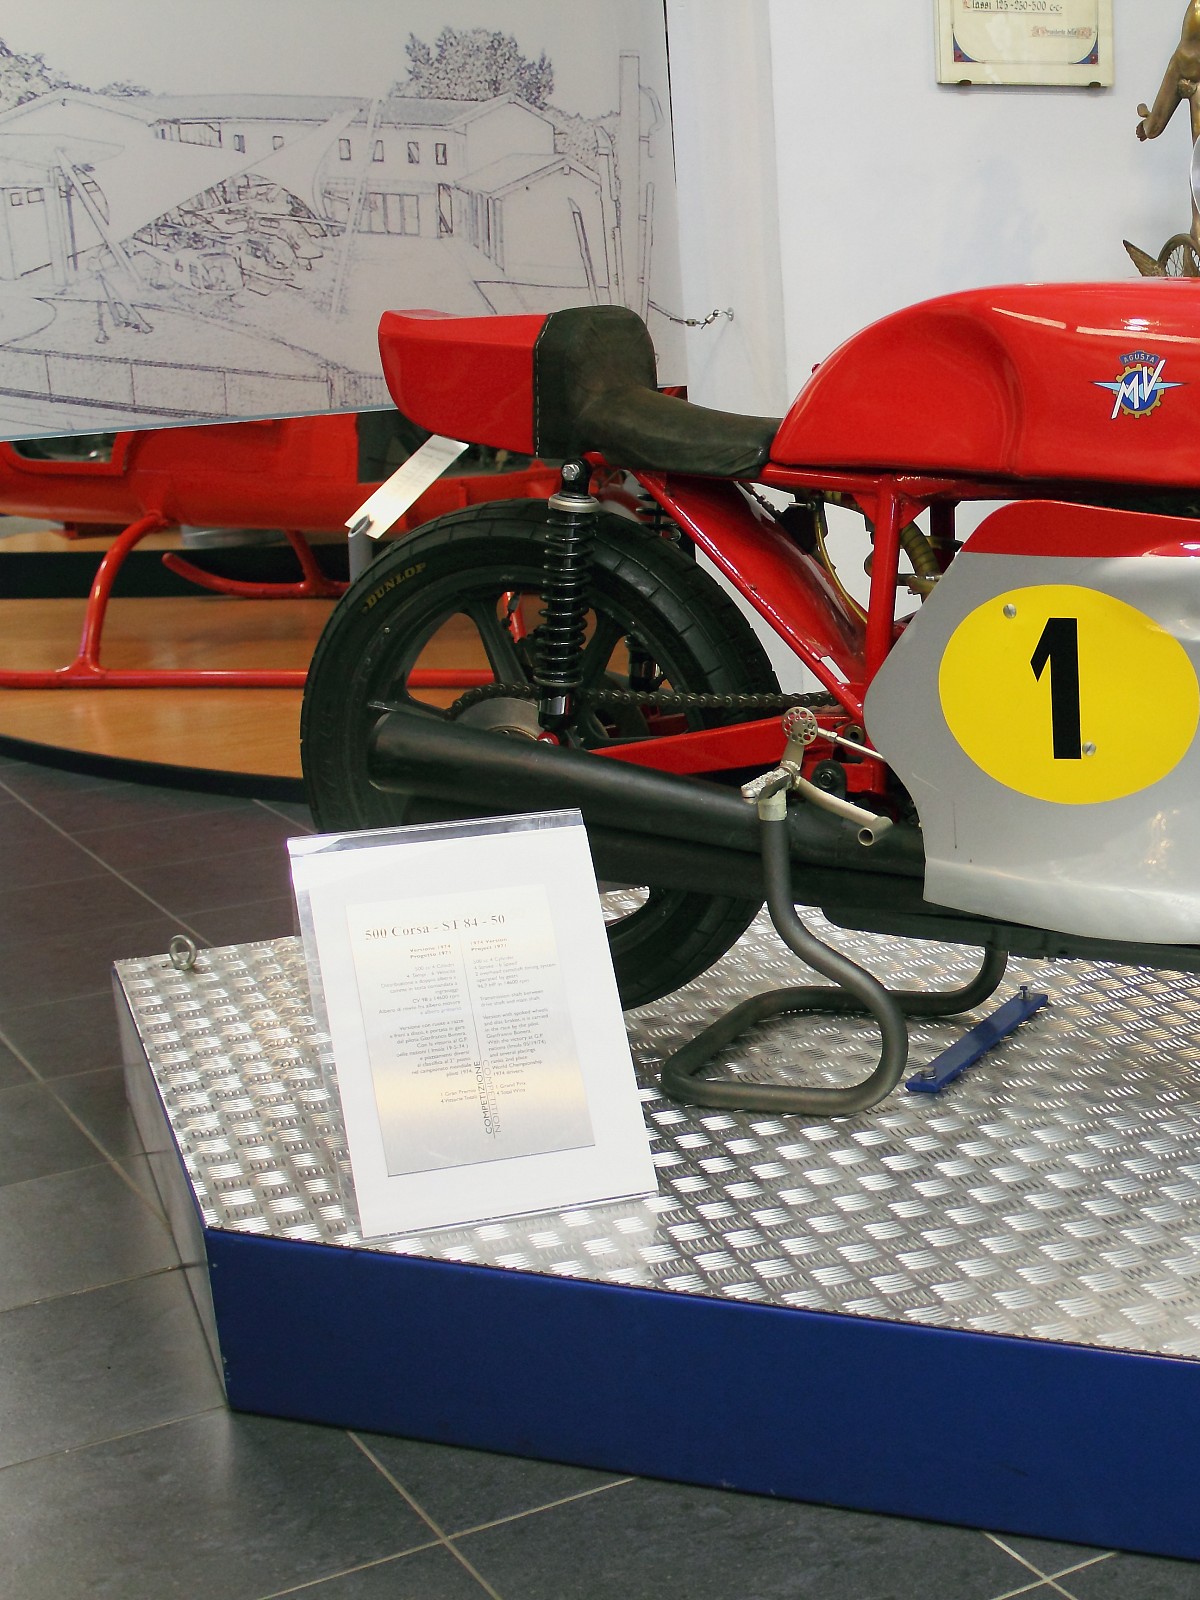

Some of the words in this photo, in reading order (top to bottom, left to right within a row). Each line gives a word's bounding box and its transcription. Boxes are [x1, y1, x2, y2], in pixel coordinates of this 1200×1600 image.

[1123, 353, 1156, 364] AGUSTA
[1111, 359, 1166, 420] MV
[366, 562, 427, 609] DUNLOP
[1028, 616, 1082, 760] 1
[364, 928, 387, 940] 500
[390, 922, 430, 937] Corsa
[441, 919, 459, 931] ST
[462, 917, 478, 928] 84
[489, 913, 505, 925] 50
[473, 1060, 493, 1135] COMPETIZIONE
[481, 1059, 501, 1133] COMPETITION
